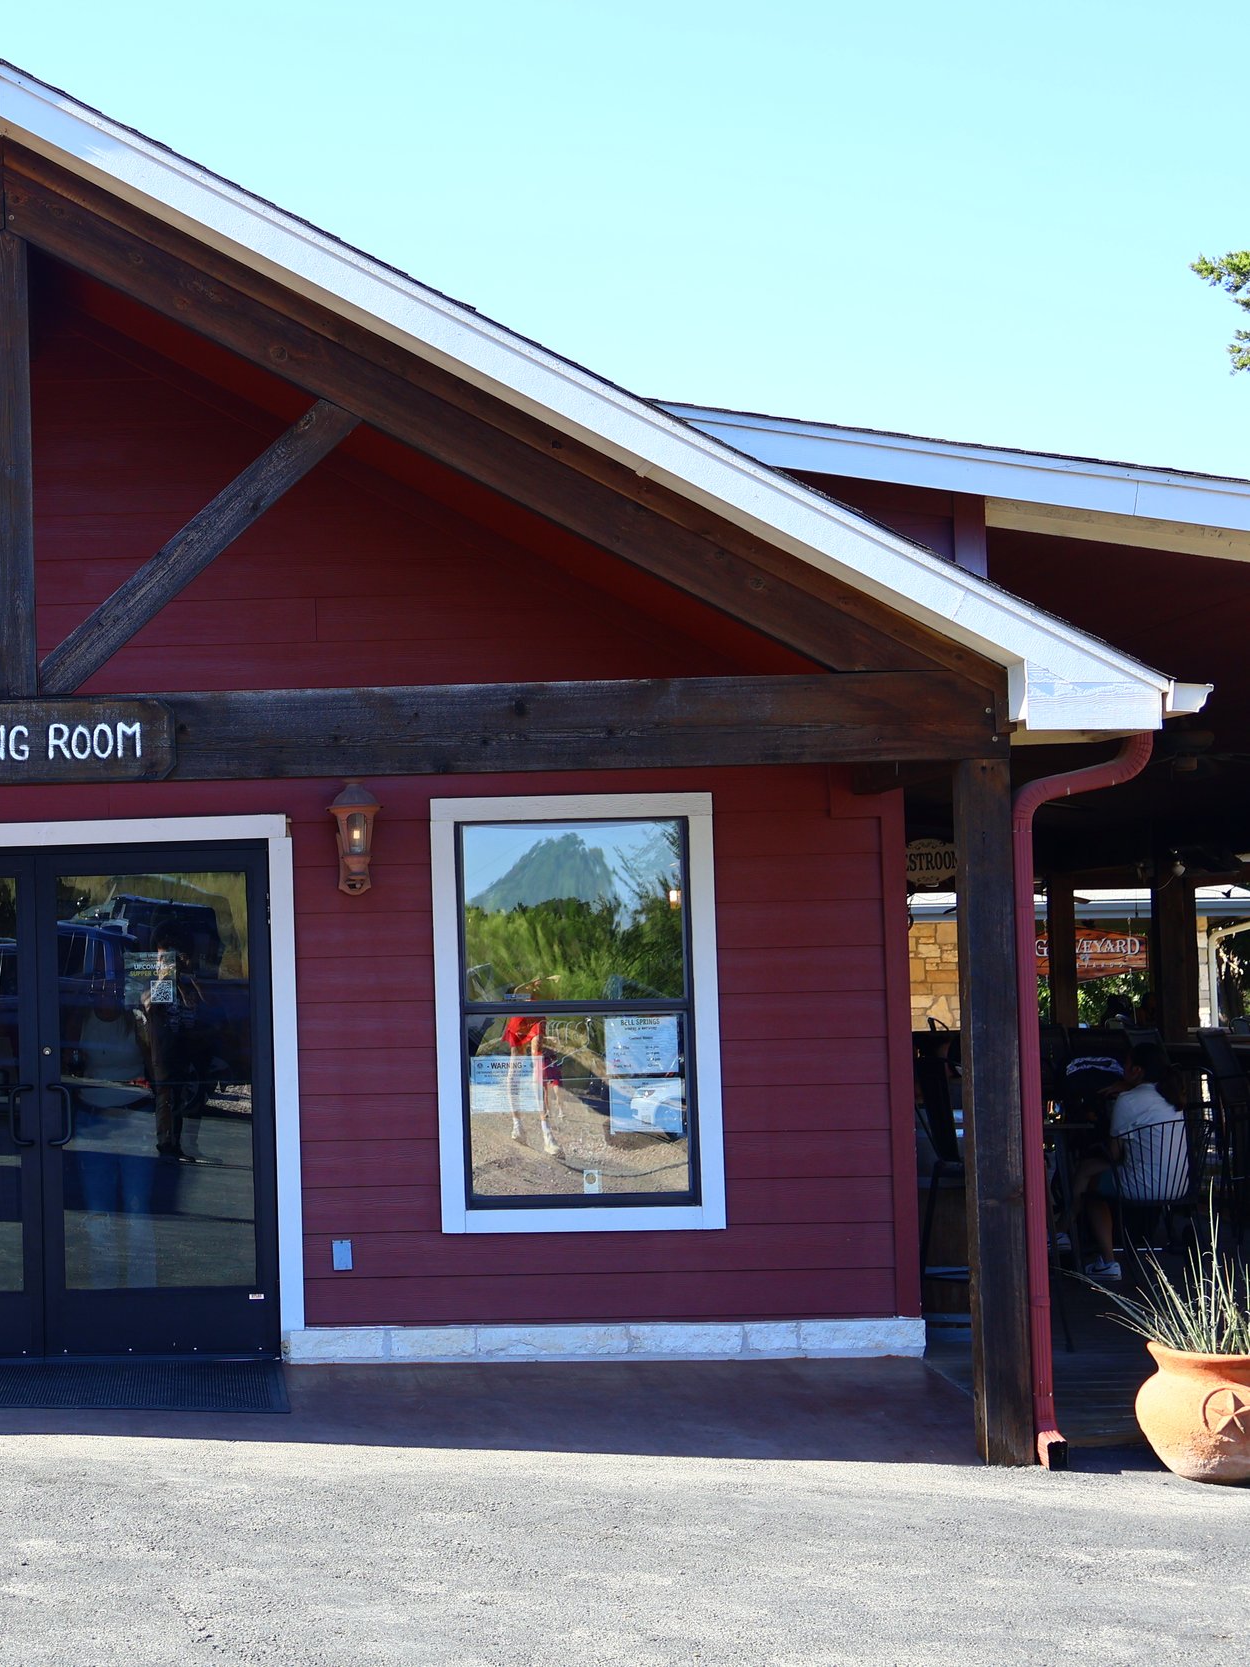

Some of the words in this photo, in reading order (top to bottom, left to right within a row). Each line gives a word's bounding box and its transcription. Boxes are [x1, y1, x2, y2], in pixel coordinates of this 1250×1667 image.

[48, 722, 142, 760] ROOM
[905, 850, 958, 872] STROO
[1035, 937, 1140, 957] GVEYARD
[636, 1018, 661, 1026] SPRINGS
[490, 1062, 523, 1070] WARNING
